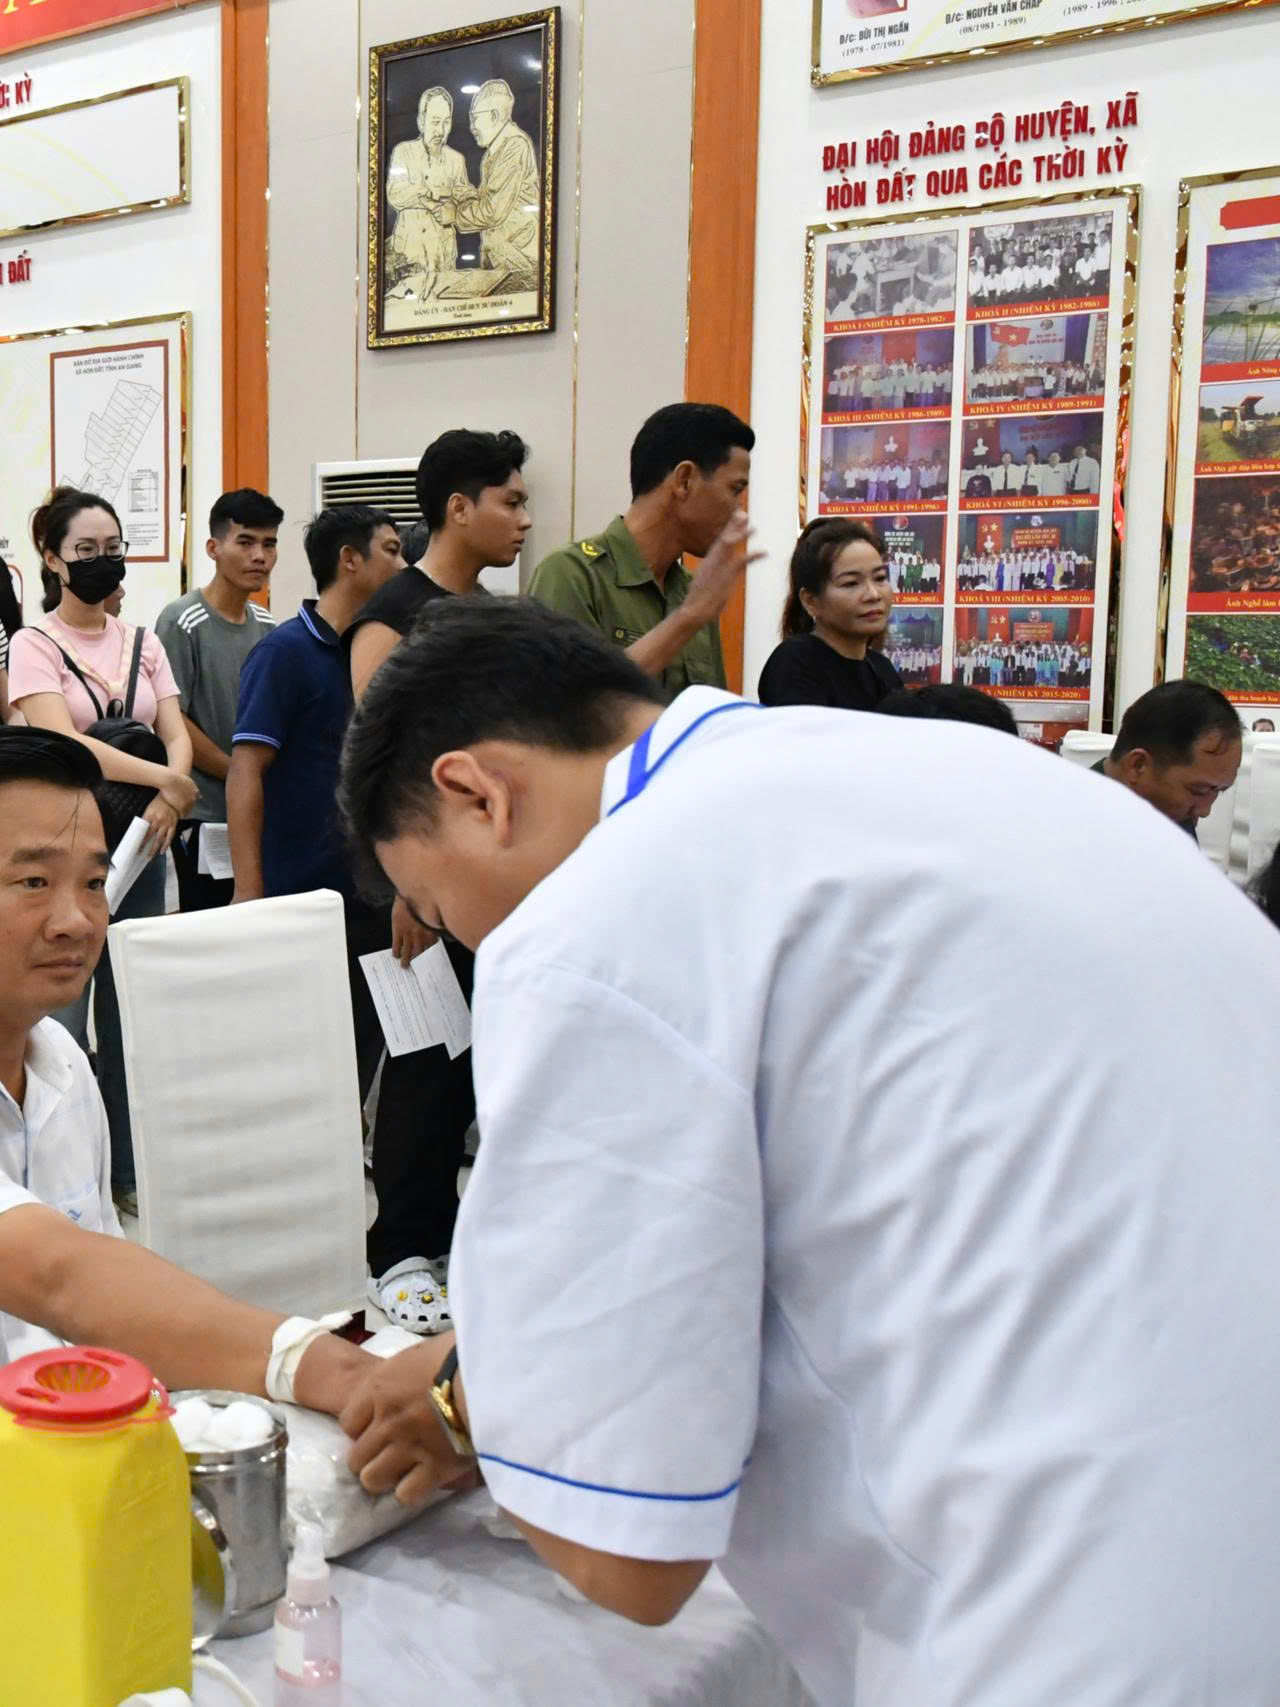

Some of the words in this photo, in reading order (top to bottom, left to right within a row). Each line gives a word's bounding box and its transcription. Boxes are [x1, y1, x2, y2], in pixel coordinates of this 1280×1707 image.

[873, 26, 886, 38] THỊ
[15, 72, 32, 105] KỲ
[823, 141, 857, 174] ĐẠI
[866, 130, 899, 168] HỘI
[908, 120, 965, 158] ĐẢNG
[975, 112, 1004, 151] BỘ
[1015, 100, 1096, 143] HUYỆN,
[1106, 91, 1138, 129] XÃ
[826, 177, 866, 211] HÒN
[876, 167, 916, 204] ĐẤT
[926, 167, 968, 197] QUA
[979, 152, 1022, 190] CÁC
[1033, 145, 1084, 182] THỜI
[1097, 136, 1128, 175] KỲ
[8, 249, 32, 284] ĐẤT
